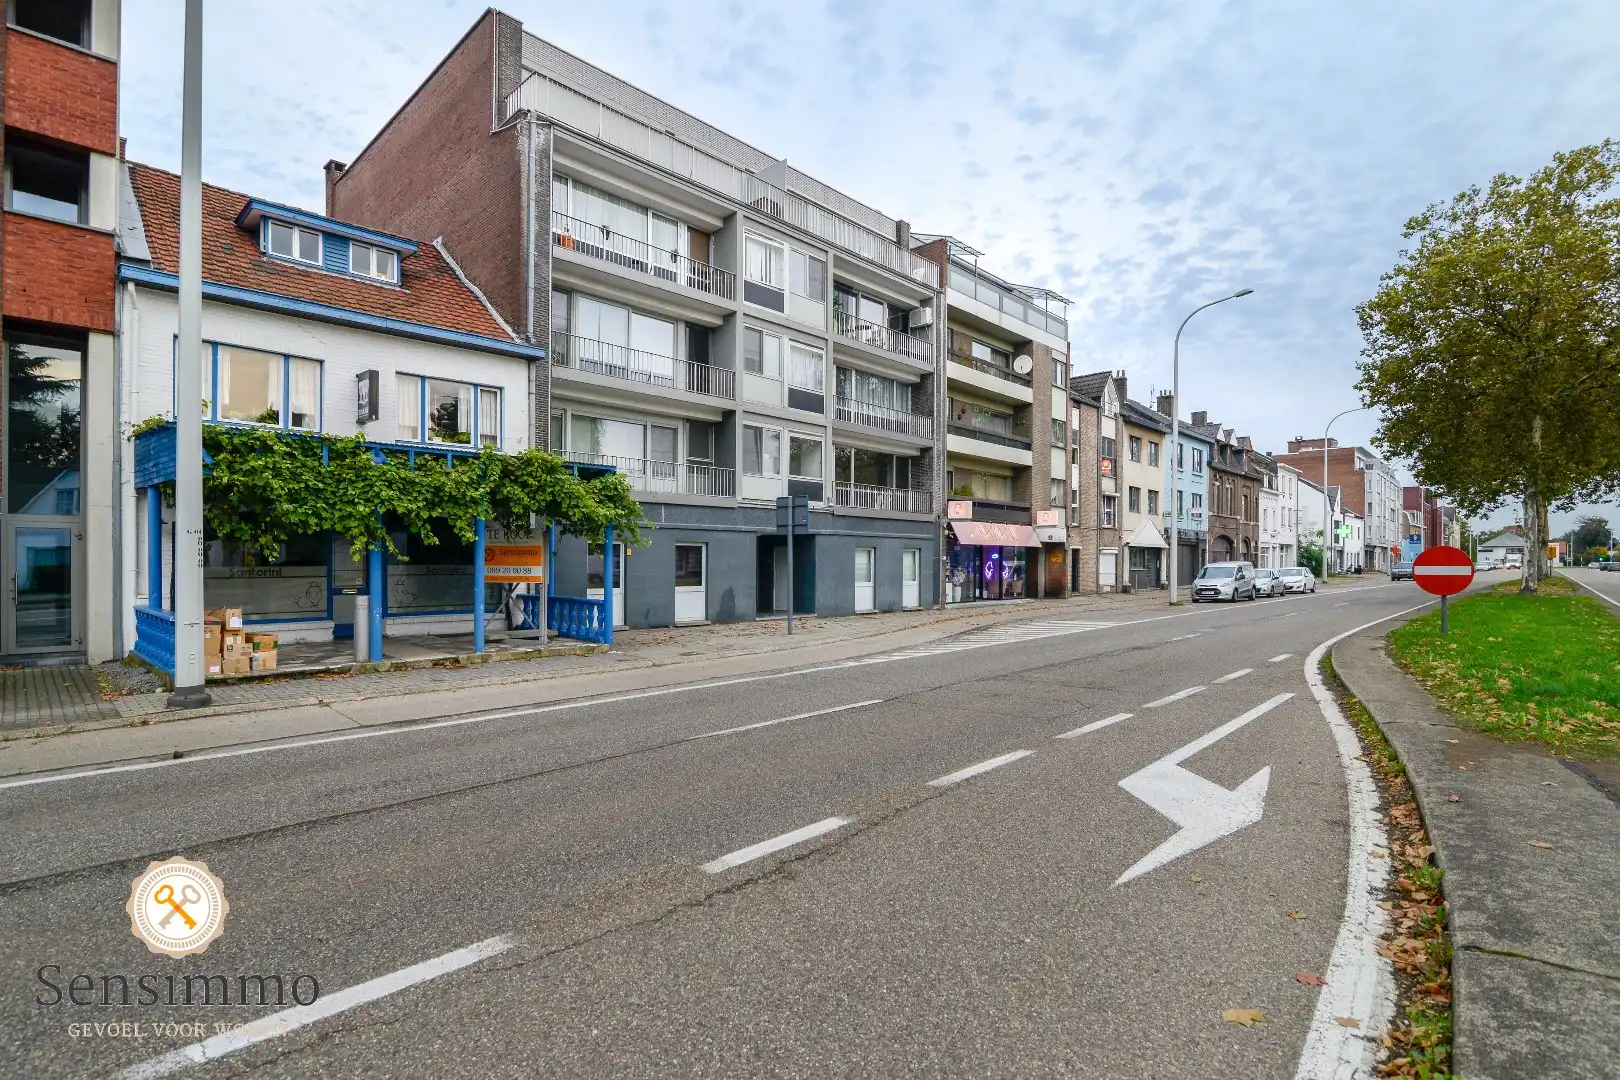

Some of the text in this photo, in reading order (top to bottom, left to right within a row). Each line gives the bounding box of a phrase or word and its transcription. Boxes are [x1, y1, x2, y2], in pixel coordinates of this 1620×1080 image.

[486, 529, 500, 539] TE
[498, 548, 537, 556] Sensimmo
[228, 567, 282, 577] Santorini
